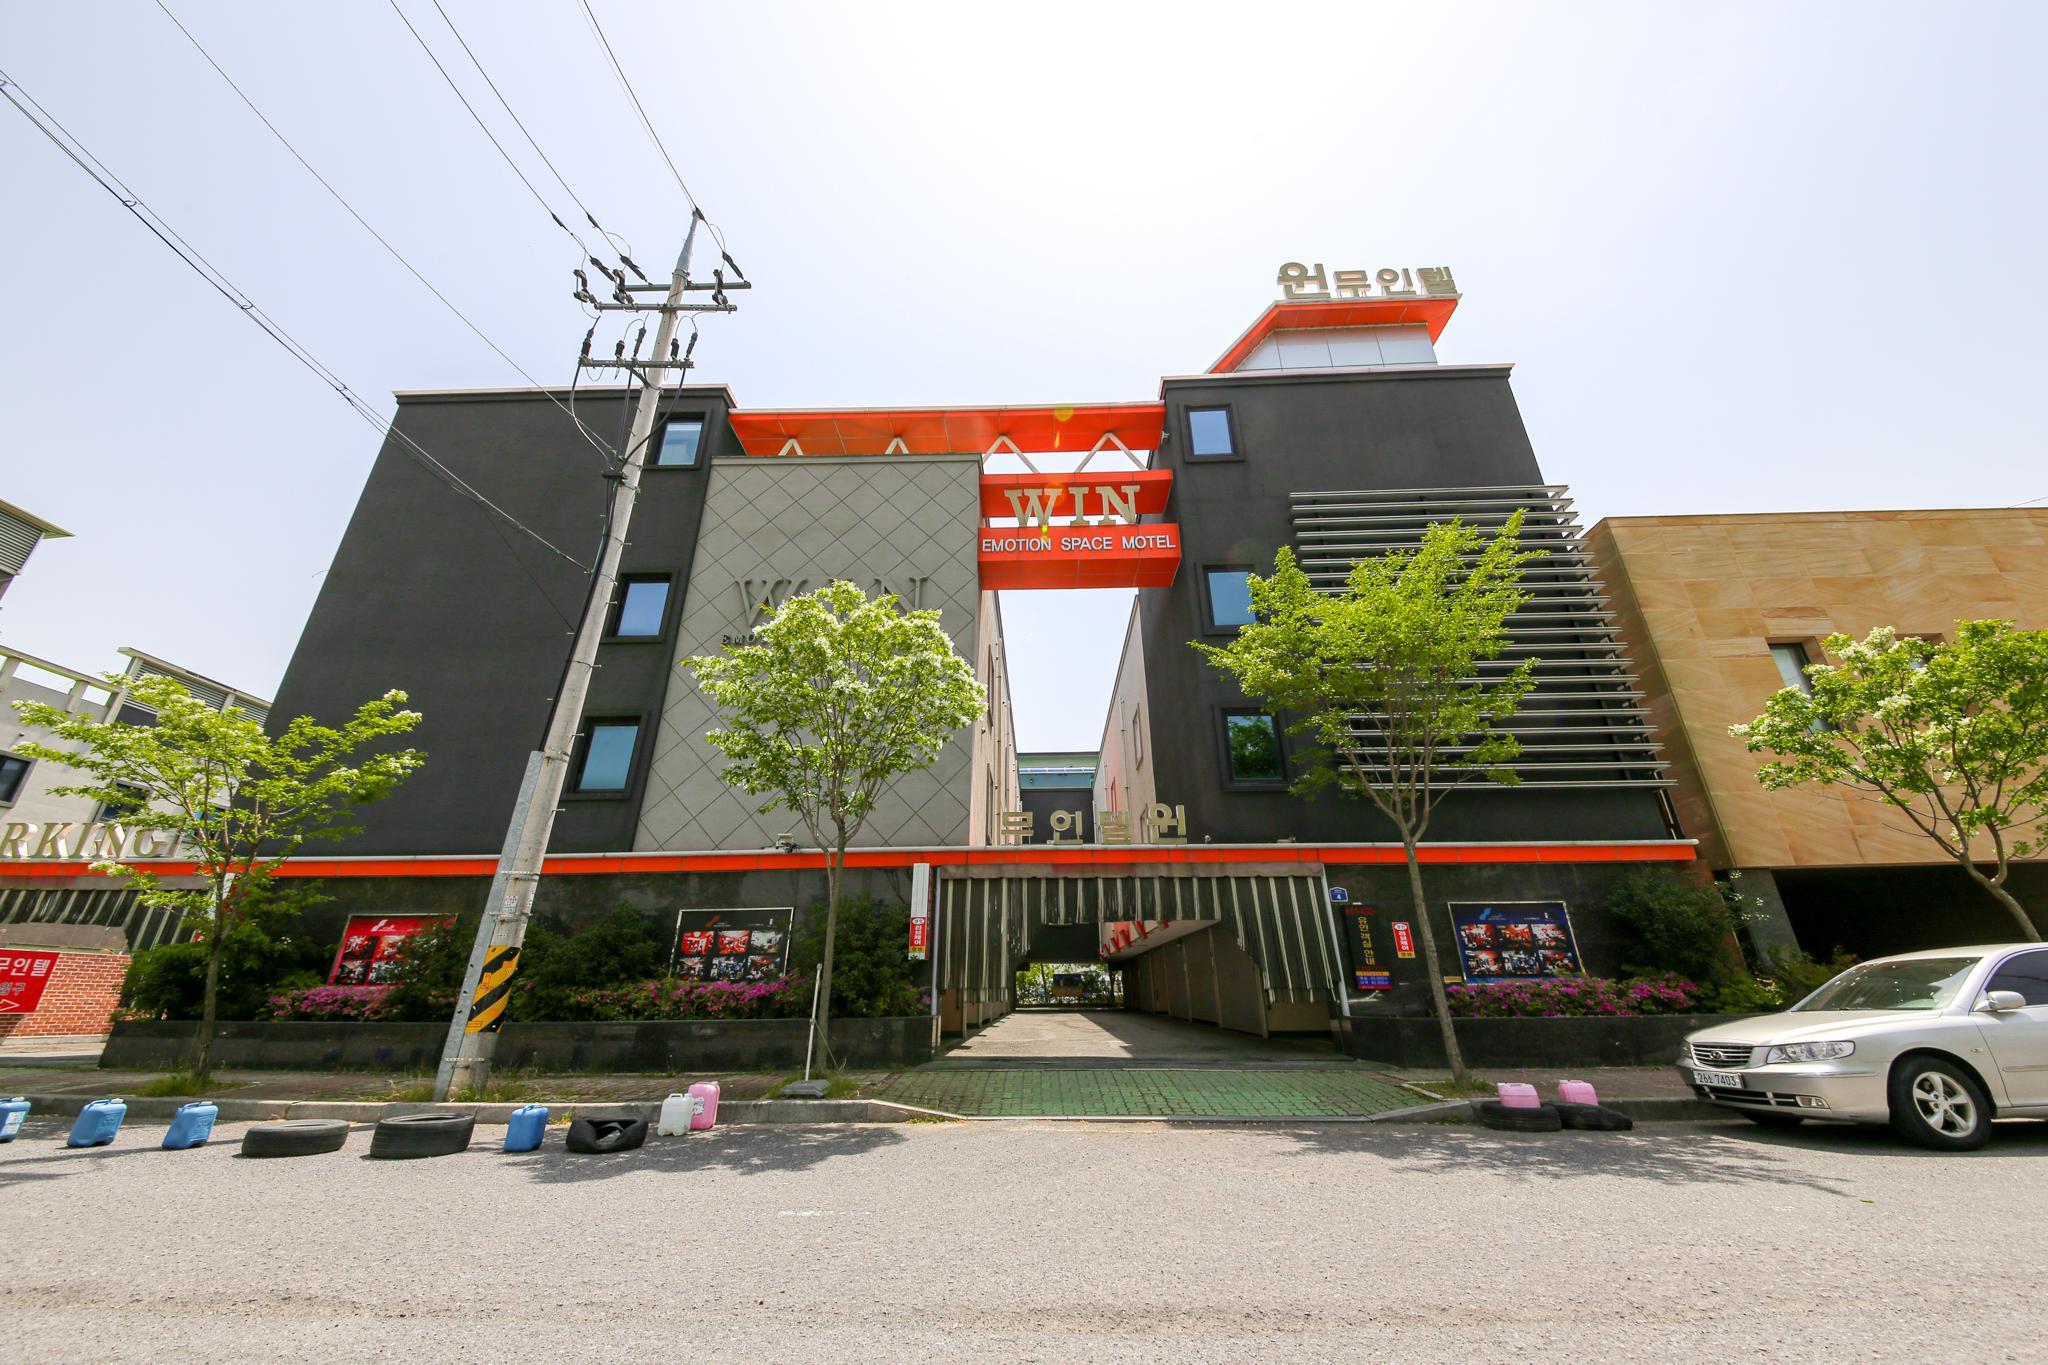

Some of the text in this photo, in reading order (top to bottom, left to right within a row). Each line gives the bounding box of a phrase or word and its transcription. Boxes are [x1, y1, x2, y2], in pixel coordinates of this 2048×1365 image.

[1003, 485, 1140, 527] WIN
[982, 535, 1177, 552] EMOTION SPACE MOTEL
[735, 576, 928, 627] WN
[1715, 1074, 1736, 1086] 7403
